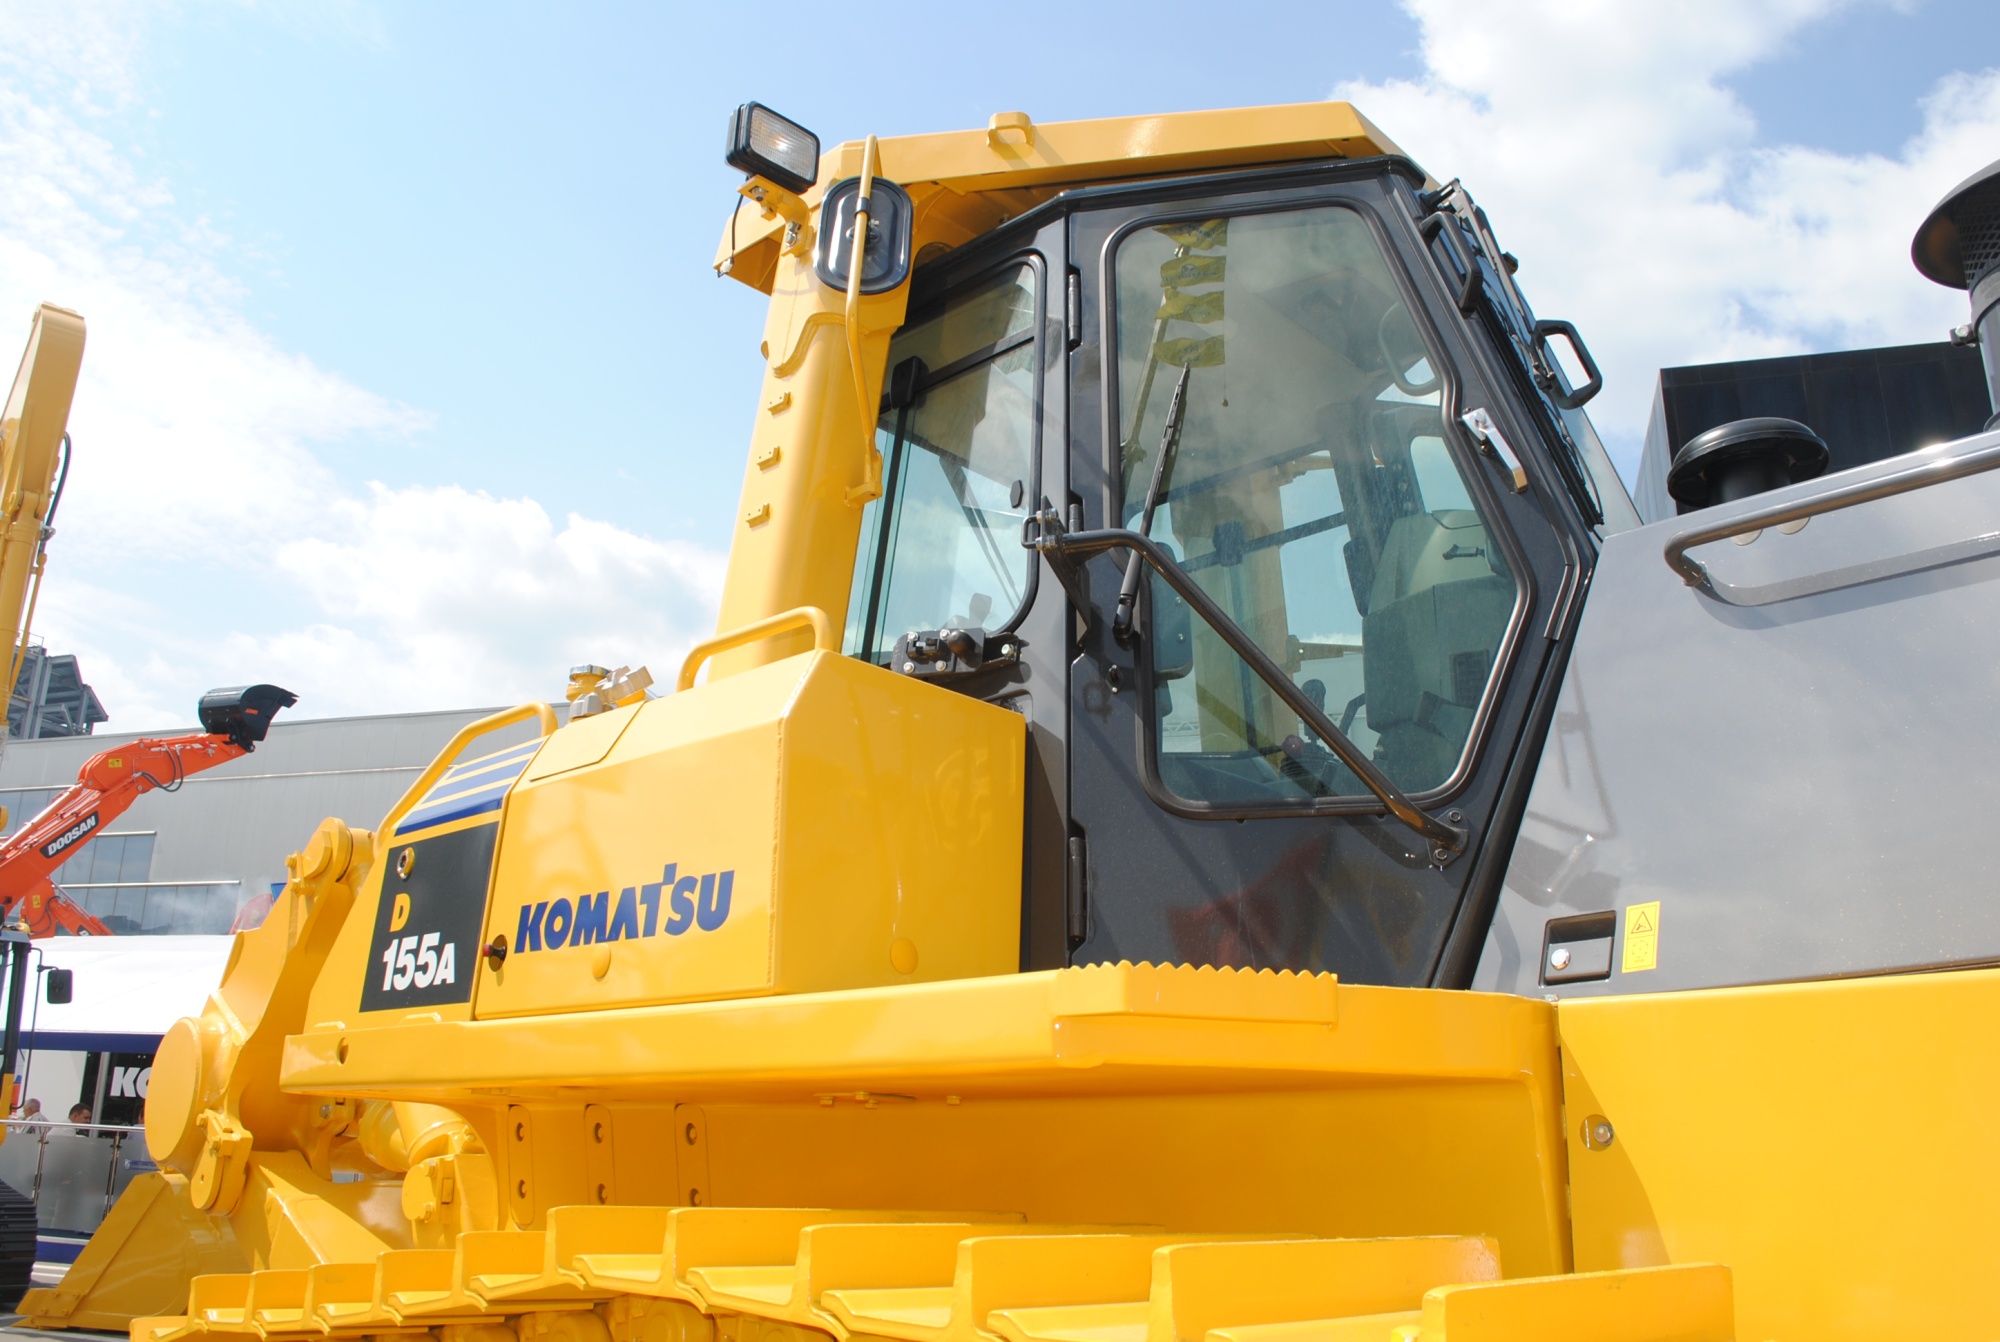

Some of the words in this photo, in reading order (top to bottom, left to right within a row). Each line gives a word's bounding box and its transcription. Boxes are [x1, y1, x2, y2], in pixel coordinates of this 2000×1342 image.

[47, 815, 97, 857] DOOSAN
[389, 892, 411, 933] D
[514, 862, 735, 954] KOMATSU
[382, 931, 455, 992] 155A
